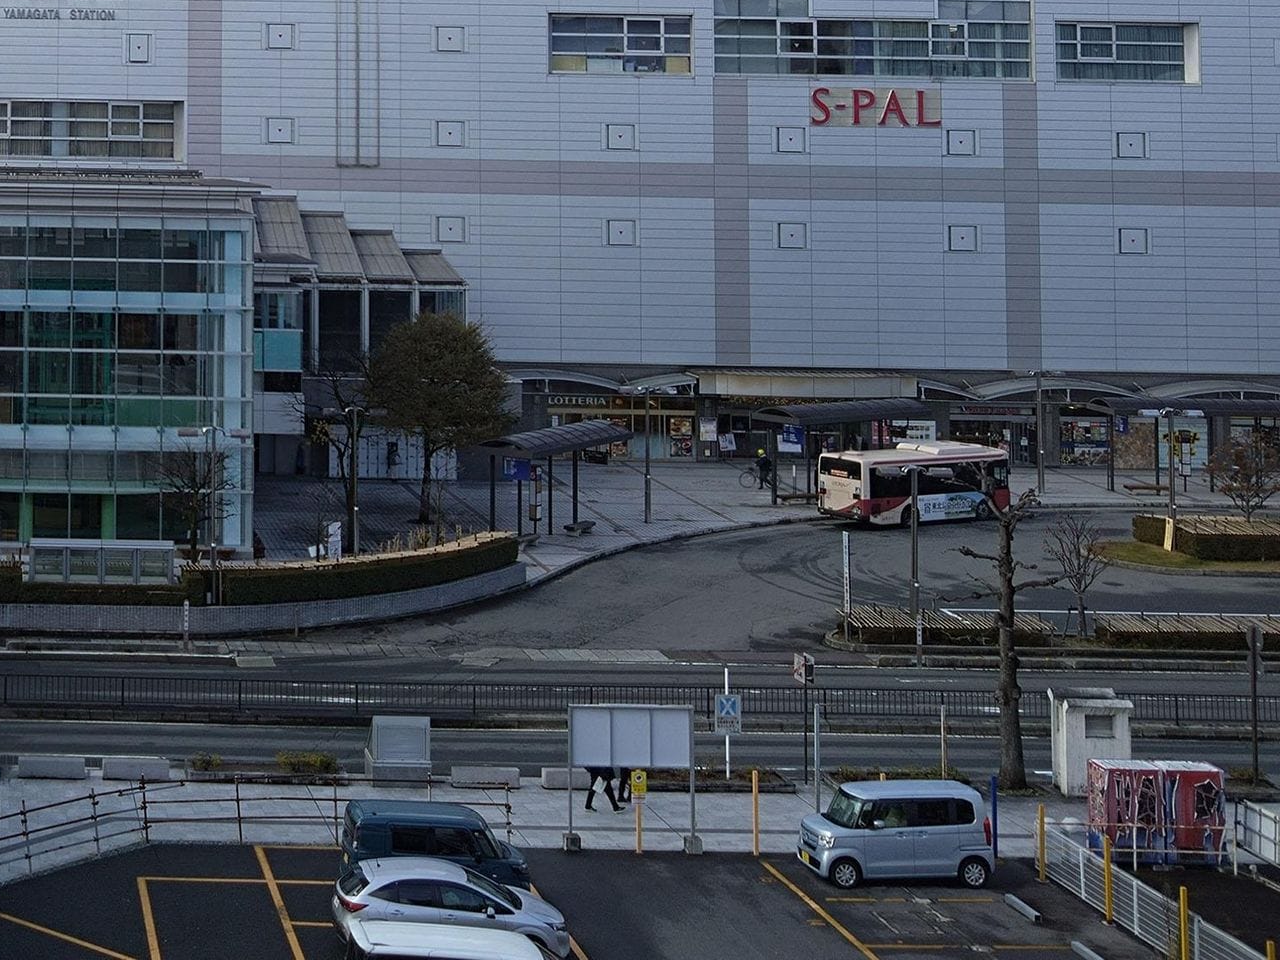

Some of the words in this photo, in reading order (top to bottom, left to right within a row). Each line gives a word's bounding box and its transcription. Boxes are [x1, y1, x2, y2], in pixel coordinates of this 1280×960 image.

[3, 7, 60, 20] YAMAGATA
[69, 8, 116, 21] STATION
[811, 87, 942, 127] S-PAL
[547, 396, 607, 406] LOTTERIA
